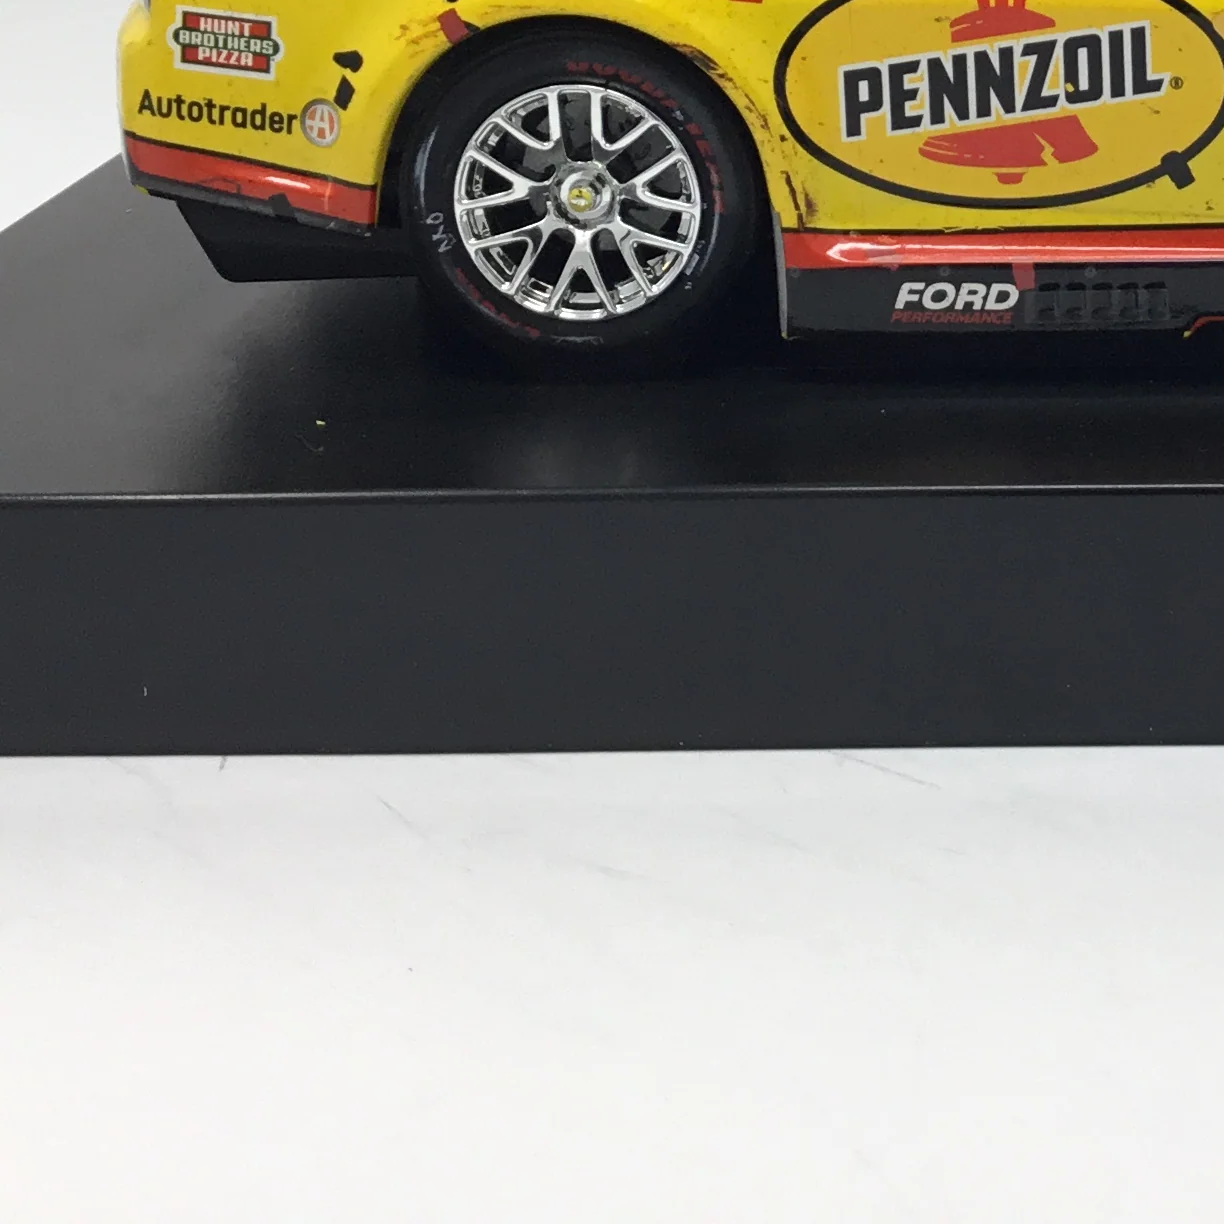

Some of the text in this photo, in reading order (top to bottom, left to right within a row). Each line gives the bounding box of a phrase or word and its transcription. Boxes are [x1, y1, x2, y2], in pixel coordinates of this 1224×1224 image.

[200, 17, 252, 36] HUNT
[179, 30, 273, 55] BROTHERS
[198, 48, 253, 67] PIZZA
[842, 26, 1167, 139] PENNZOIL
[138, 89, 298, 135] Autotrader
[894, 282, 1020, 310] FORD
[890, 311, 1015, 325] PERFORMANCE
